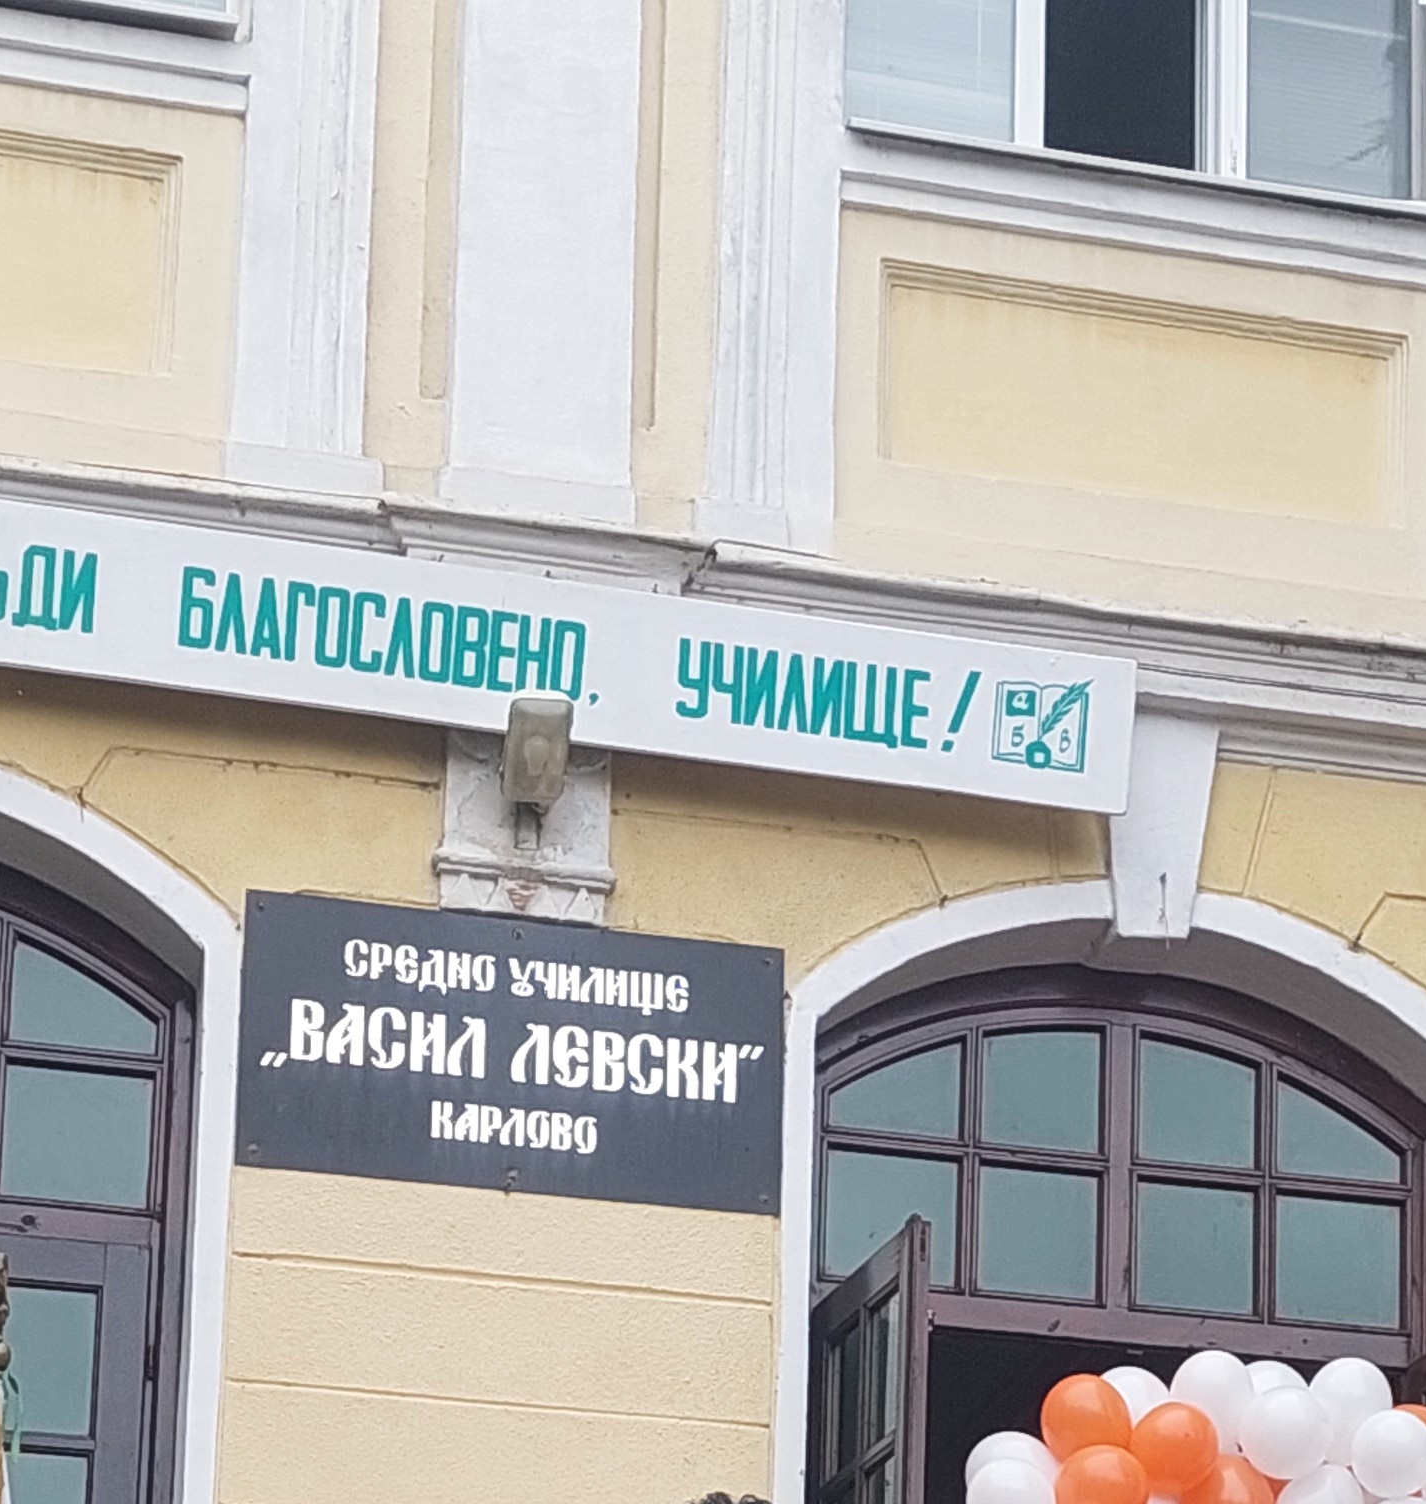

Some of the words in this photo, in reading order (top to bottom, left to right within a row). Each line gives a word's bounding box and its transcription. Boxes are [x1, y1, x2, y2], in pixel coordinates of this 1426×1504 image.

[177, 565, 601, 708] БЛАГОСЛОВЕНО,
[344, 938, 496, 996] СРЕДНО
[507, 956, 690, 1017] УЧИЛИЩЕ
[429, 1099, 599, 1155] КАРЛОВО
